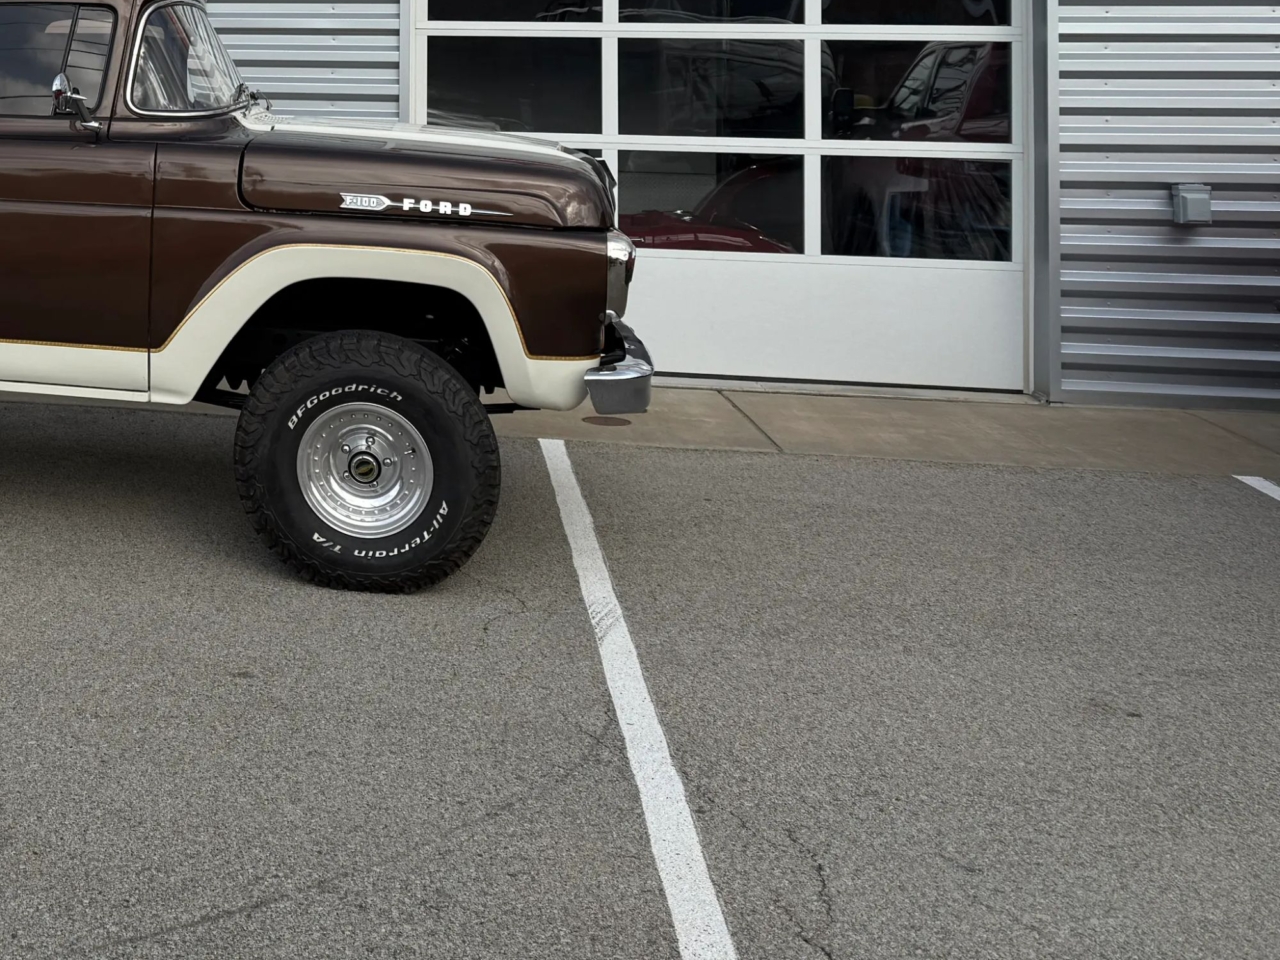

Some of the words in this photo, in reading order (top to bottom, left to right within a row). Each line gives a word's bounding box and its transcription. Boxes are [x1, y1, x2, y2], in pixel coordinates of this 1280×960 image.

[402, 198, 472, 216] FORD
[287, 383, 403, 430] BFGoodrich
[311, 531, 342, 553] T/A
